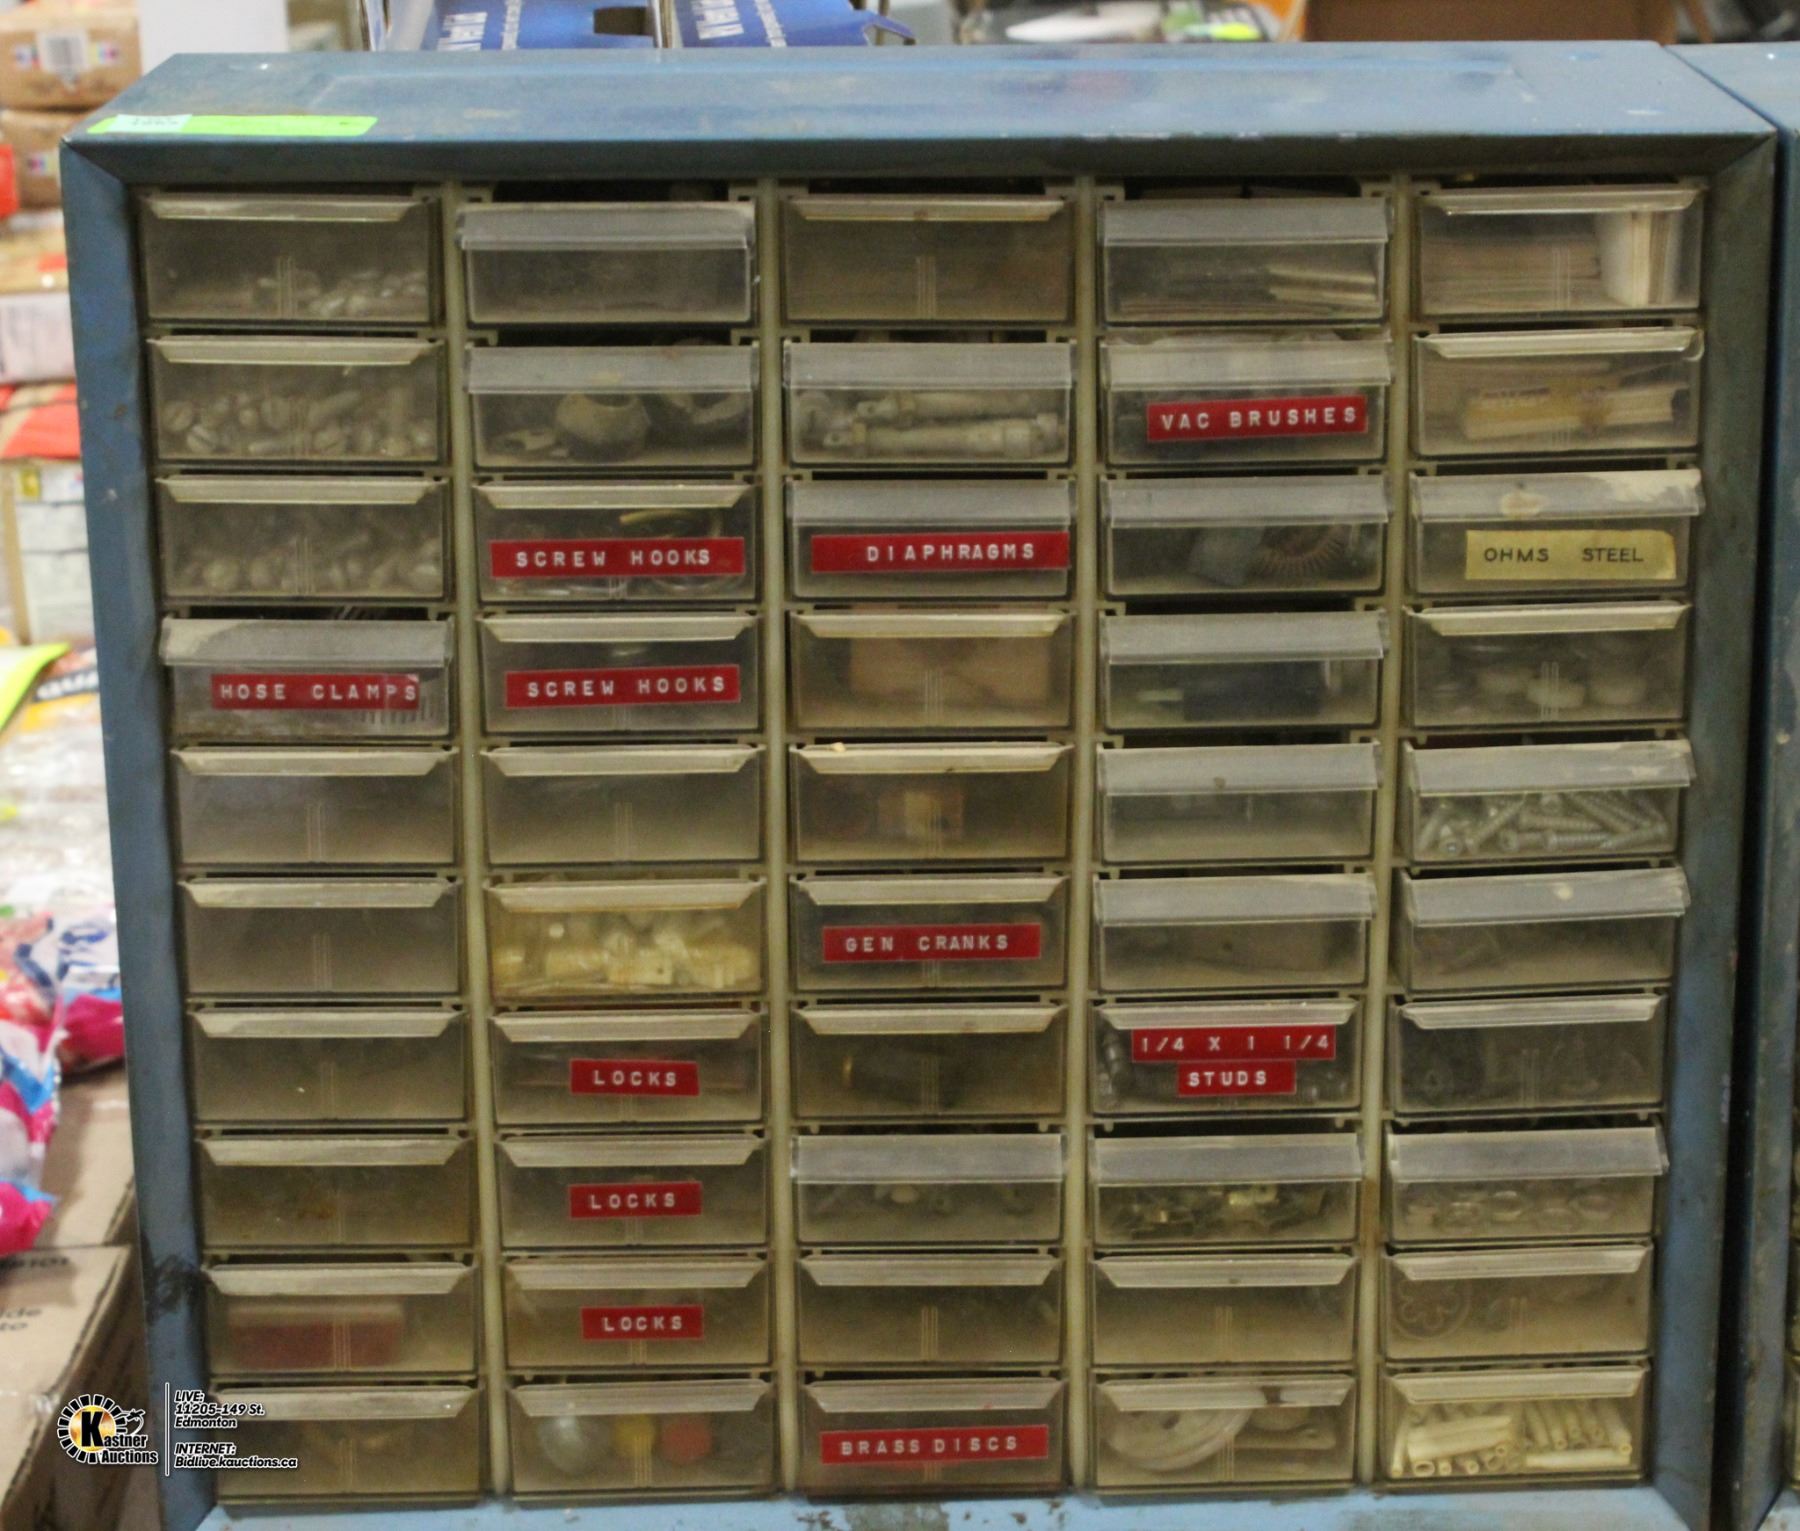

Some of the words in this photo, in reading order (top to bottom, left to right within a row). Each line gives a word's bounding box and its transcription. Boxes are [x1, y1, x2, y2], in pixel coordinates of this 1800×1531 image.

[1161, 413, 1209, 431] VAC
[1229, 407, 1355, 428] BRUSHES
[515, 551, 606, 567] SCREW
[630, 549, 710, 566] HOOKS
[866, 543, 1034, 562] DIAPHRAGMS
[1483, 547, 1549, 563] OHMS
[1581, 548, 1643, 563] STEEL
[220, 684, 286, 700] HOSE
[311, 684, 416, 701] CLAMPS
[526, 680, 614, 698] SCREW
[638, 676, 724, 694] HOOKS
[845, 937, 893, 953] GEN
[917, 935, 1008, 951] CRANKS
[1142, 1037, 1184, 1052] 1/4
[1208, 1036, 1220, 1051] X
[1284, 1035, 1329, 1050] 1/4
[593, 1070, 676, 1087] LOCKS
[1188, 1070, 1266, 1087] STUDS
[590, 1193, 675, 1209] LOCKS
[602, 1315, 682, 1332] LOCKS
[841, 1439, 920, 1456] BRASS
[934, 1436, 1017, 1453] DISCS
